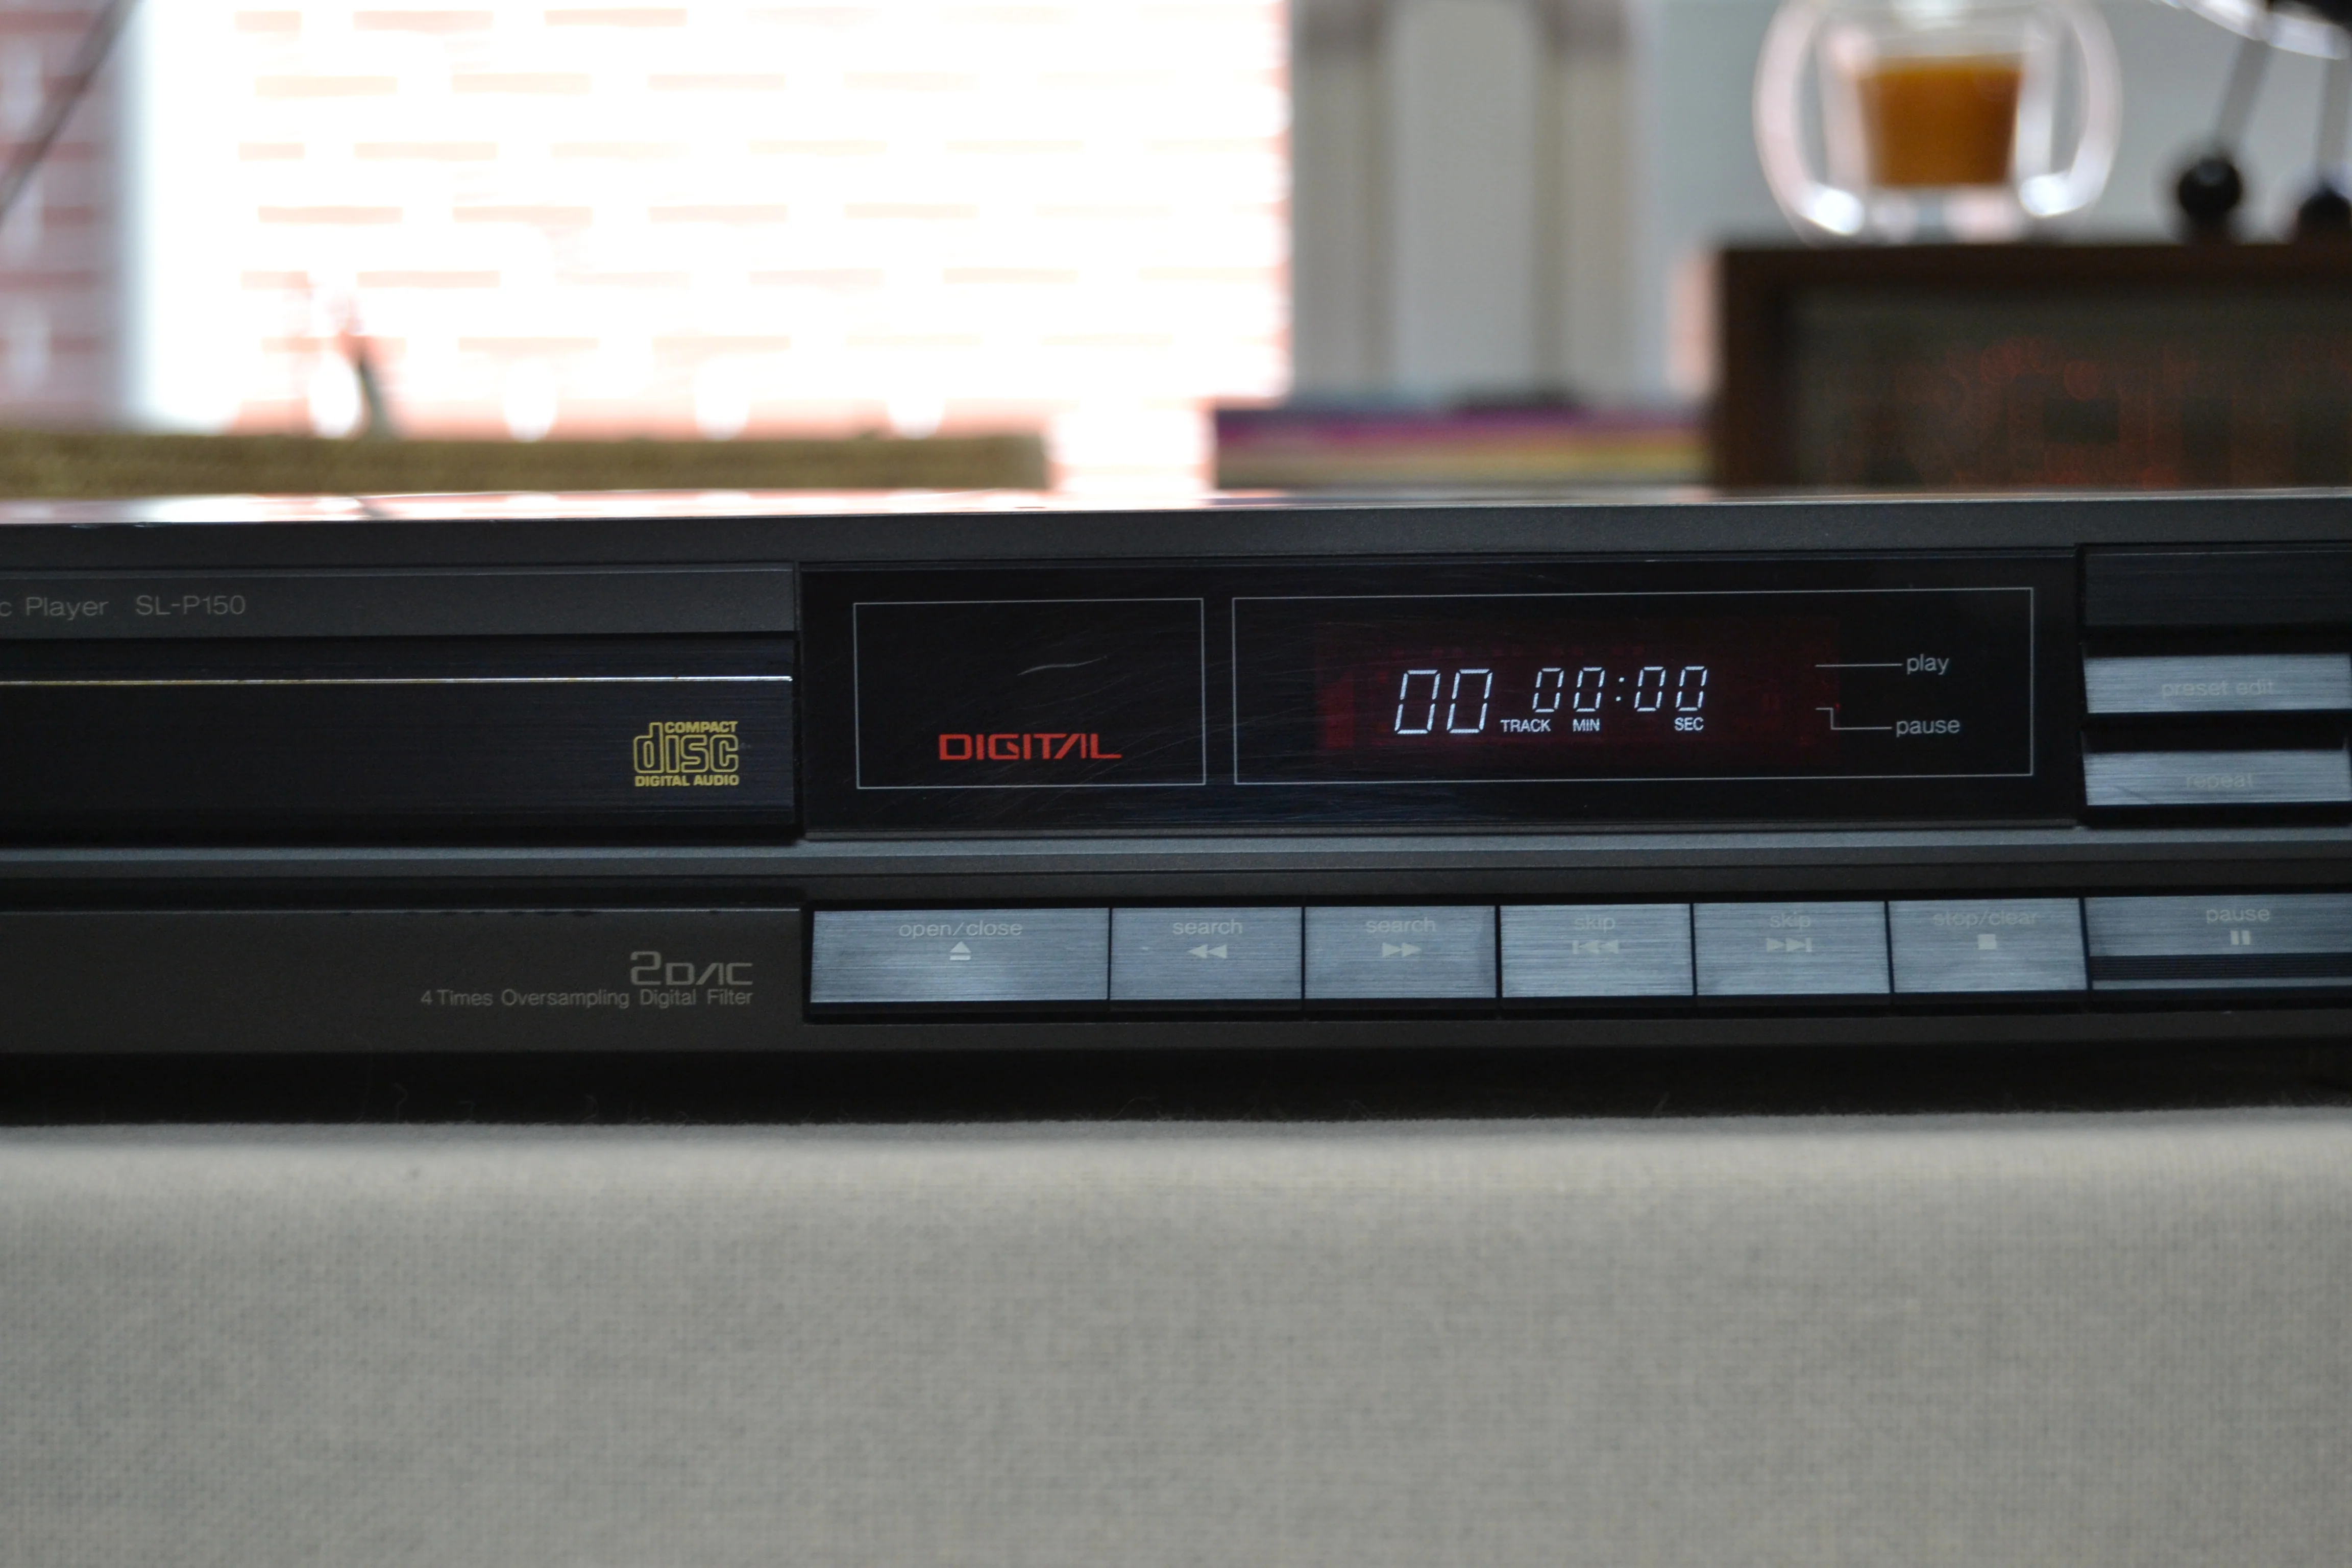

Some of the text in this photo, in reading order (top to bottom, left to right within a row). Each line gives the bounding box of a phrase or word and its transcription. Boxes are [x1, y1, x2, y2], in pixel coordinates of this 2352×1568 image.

[26, 597, 109, 621] Player
[135, 595, 246, 616] SL-P150
[1906, 653, 1950, 675] play
[2161, 679, 2275, 699] preset edit
[1394, 666, 1707, 734] 00 00:00
[664, 721, 739, 734] COMPACT
[1501, 717, 1704, 733] TRACK MIN SEC
[1896, 718, 1961, 738] pause
[939, 732, 1122, 761] DIGITAL
[634, 774, 740, 787] DIGITAL AUDIO
[2185, 772, 2255, 792] repeat
[1365, 916, 1437, 933] search
[1574, 915, 1616, 933] skip
[1769, 911, 1811, 930] skip
[1932, 909, 2039, 927] stop/clear
[2206, 906, 2272, 924] pause
[898, 920, 1023, 939] open/close
[1172, 918, 1243, 935] search
[420, 988, 753, 1009] 4 Times Oversampling Digital Filter
